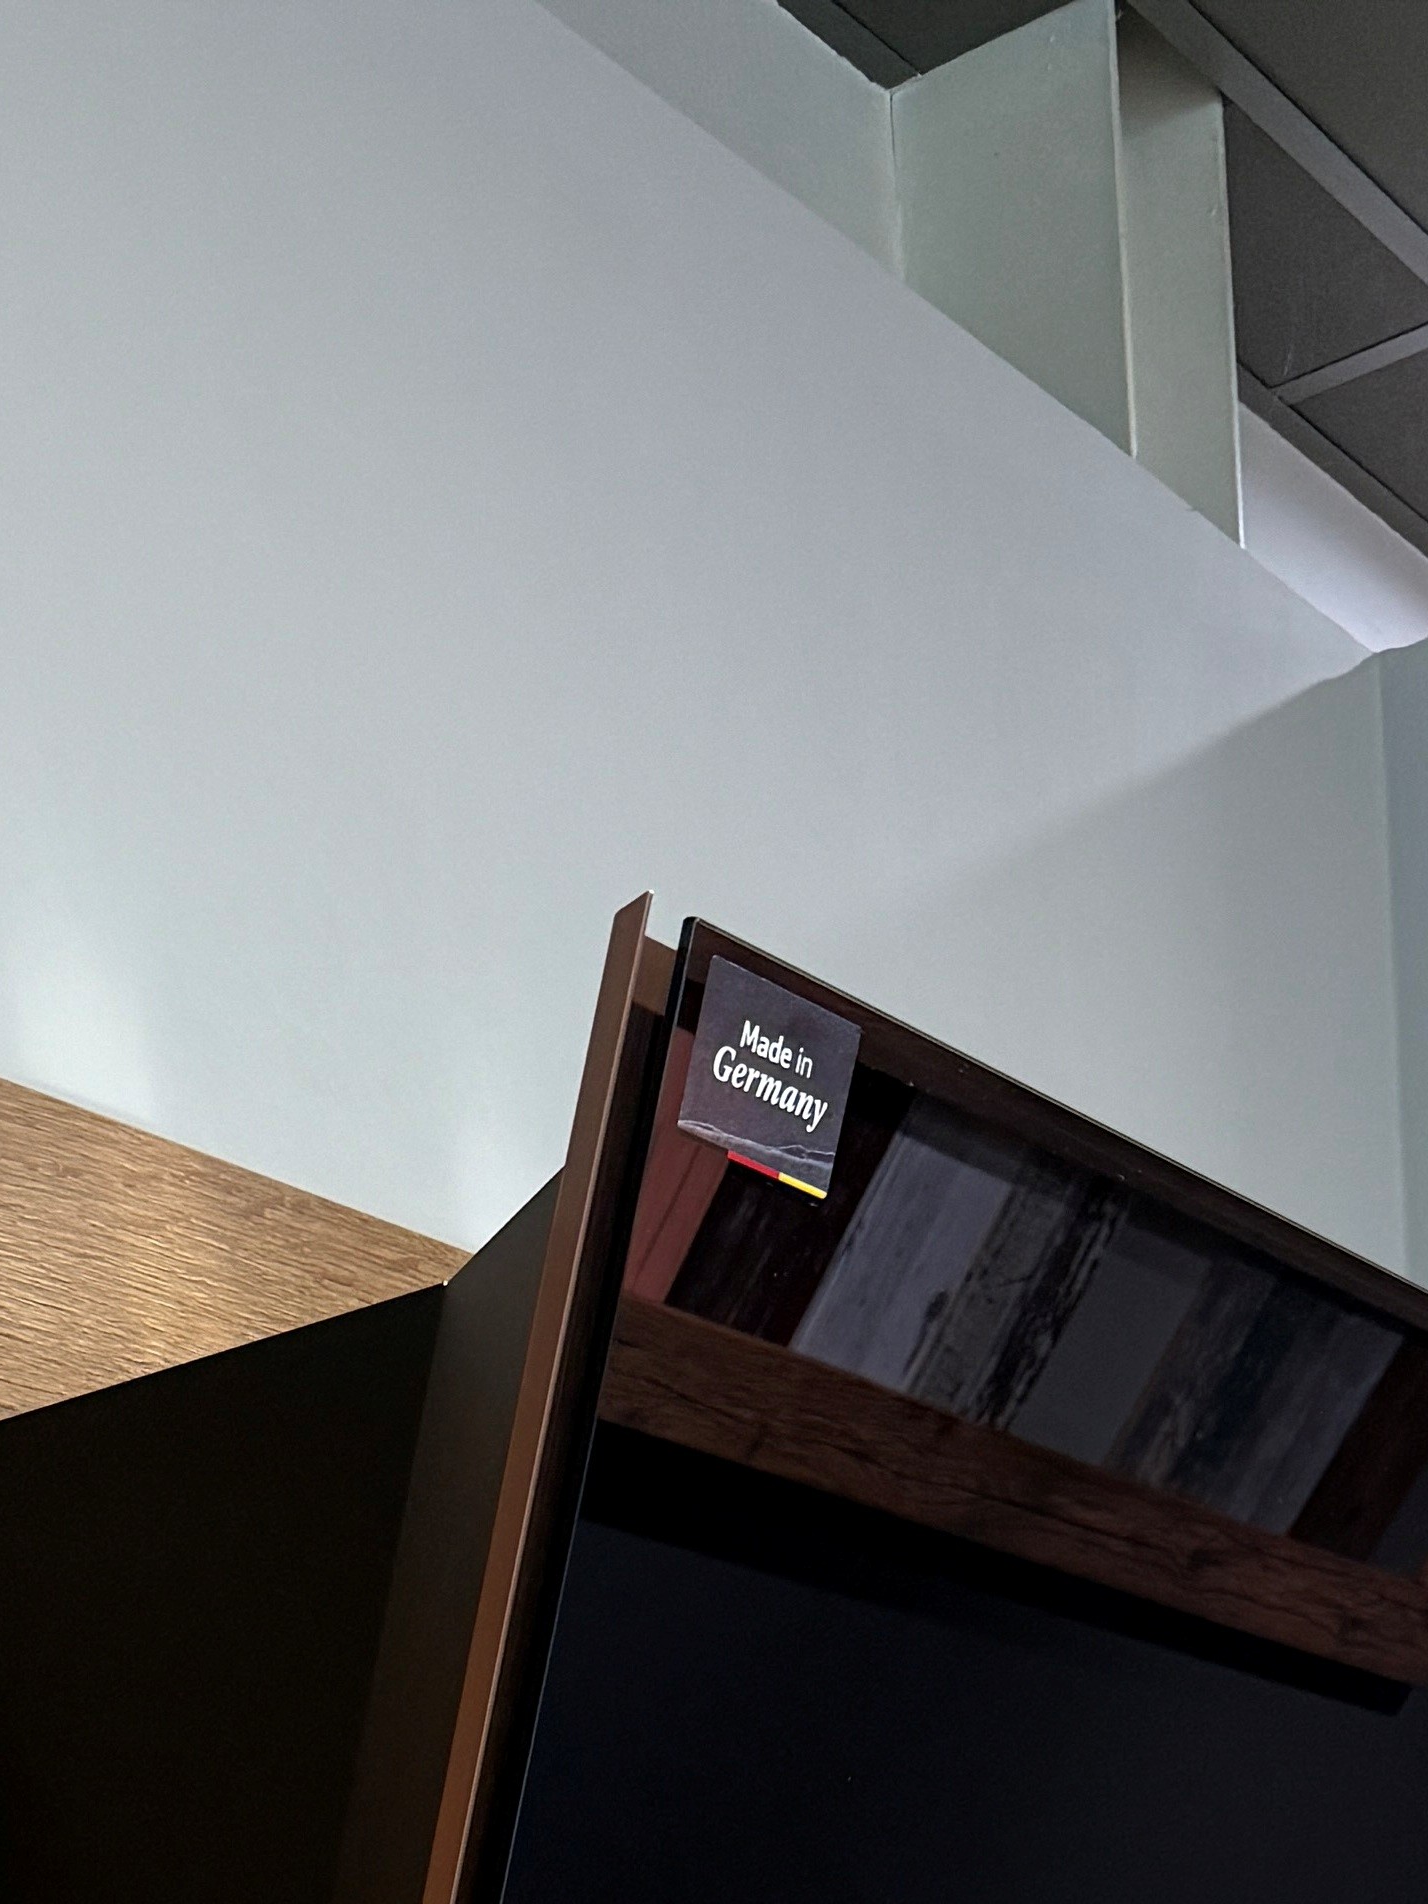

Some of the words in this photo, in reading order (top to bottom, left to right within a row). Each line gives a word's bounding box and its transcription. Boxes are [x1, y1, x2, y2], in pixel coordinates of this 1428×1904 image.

[739, 1020, 792, 1069] Made
[795, 1047, 813, 1078] in
[712, 1045, 828, 1133] Germany
